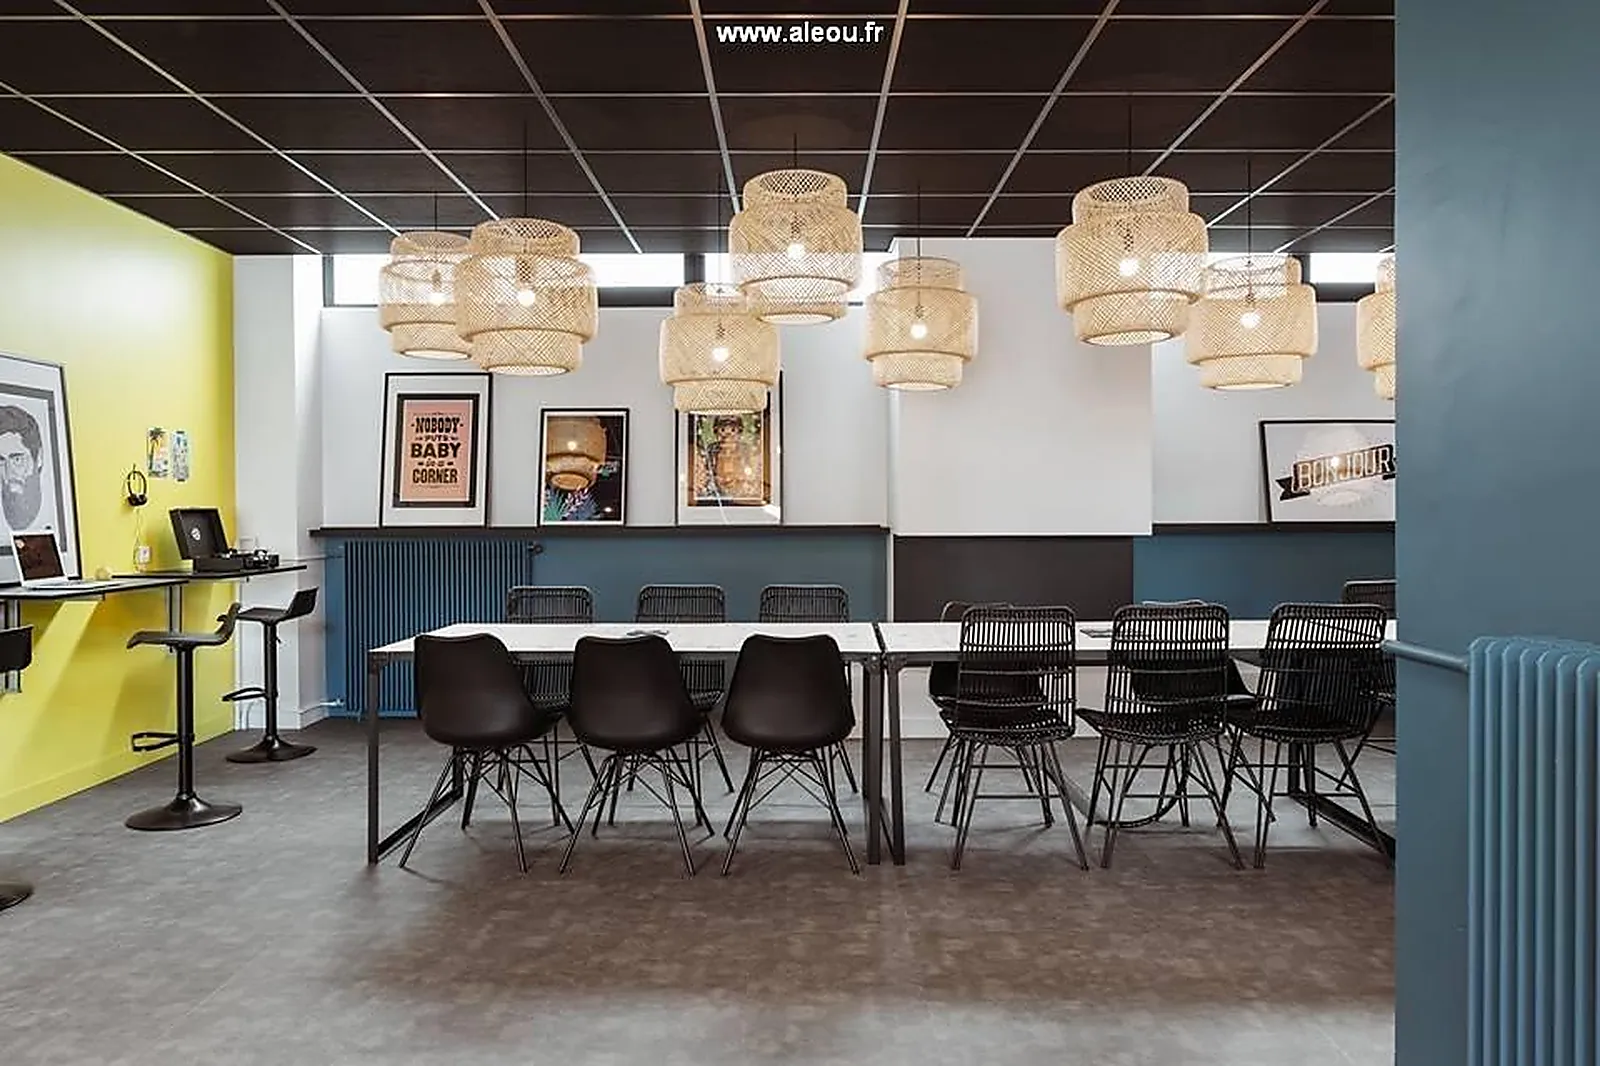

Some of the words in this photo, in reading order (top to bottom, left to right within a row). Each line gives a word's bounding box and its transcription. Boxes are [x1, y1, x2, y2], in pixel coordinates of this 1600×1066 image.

[415, 417, 460, 433] NOBODY
[424, 434, 449, 442] PUTS
[411, 442, 461, 458] BABY
[1298, 446, 1391, 489] BONJOUR
[412, 468, 458, 484] CORNER
